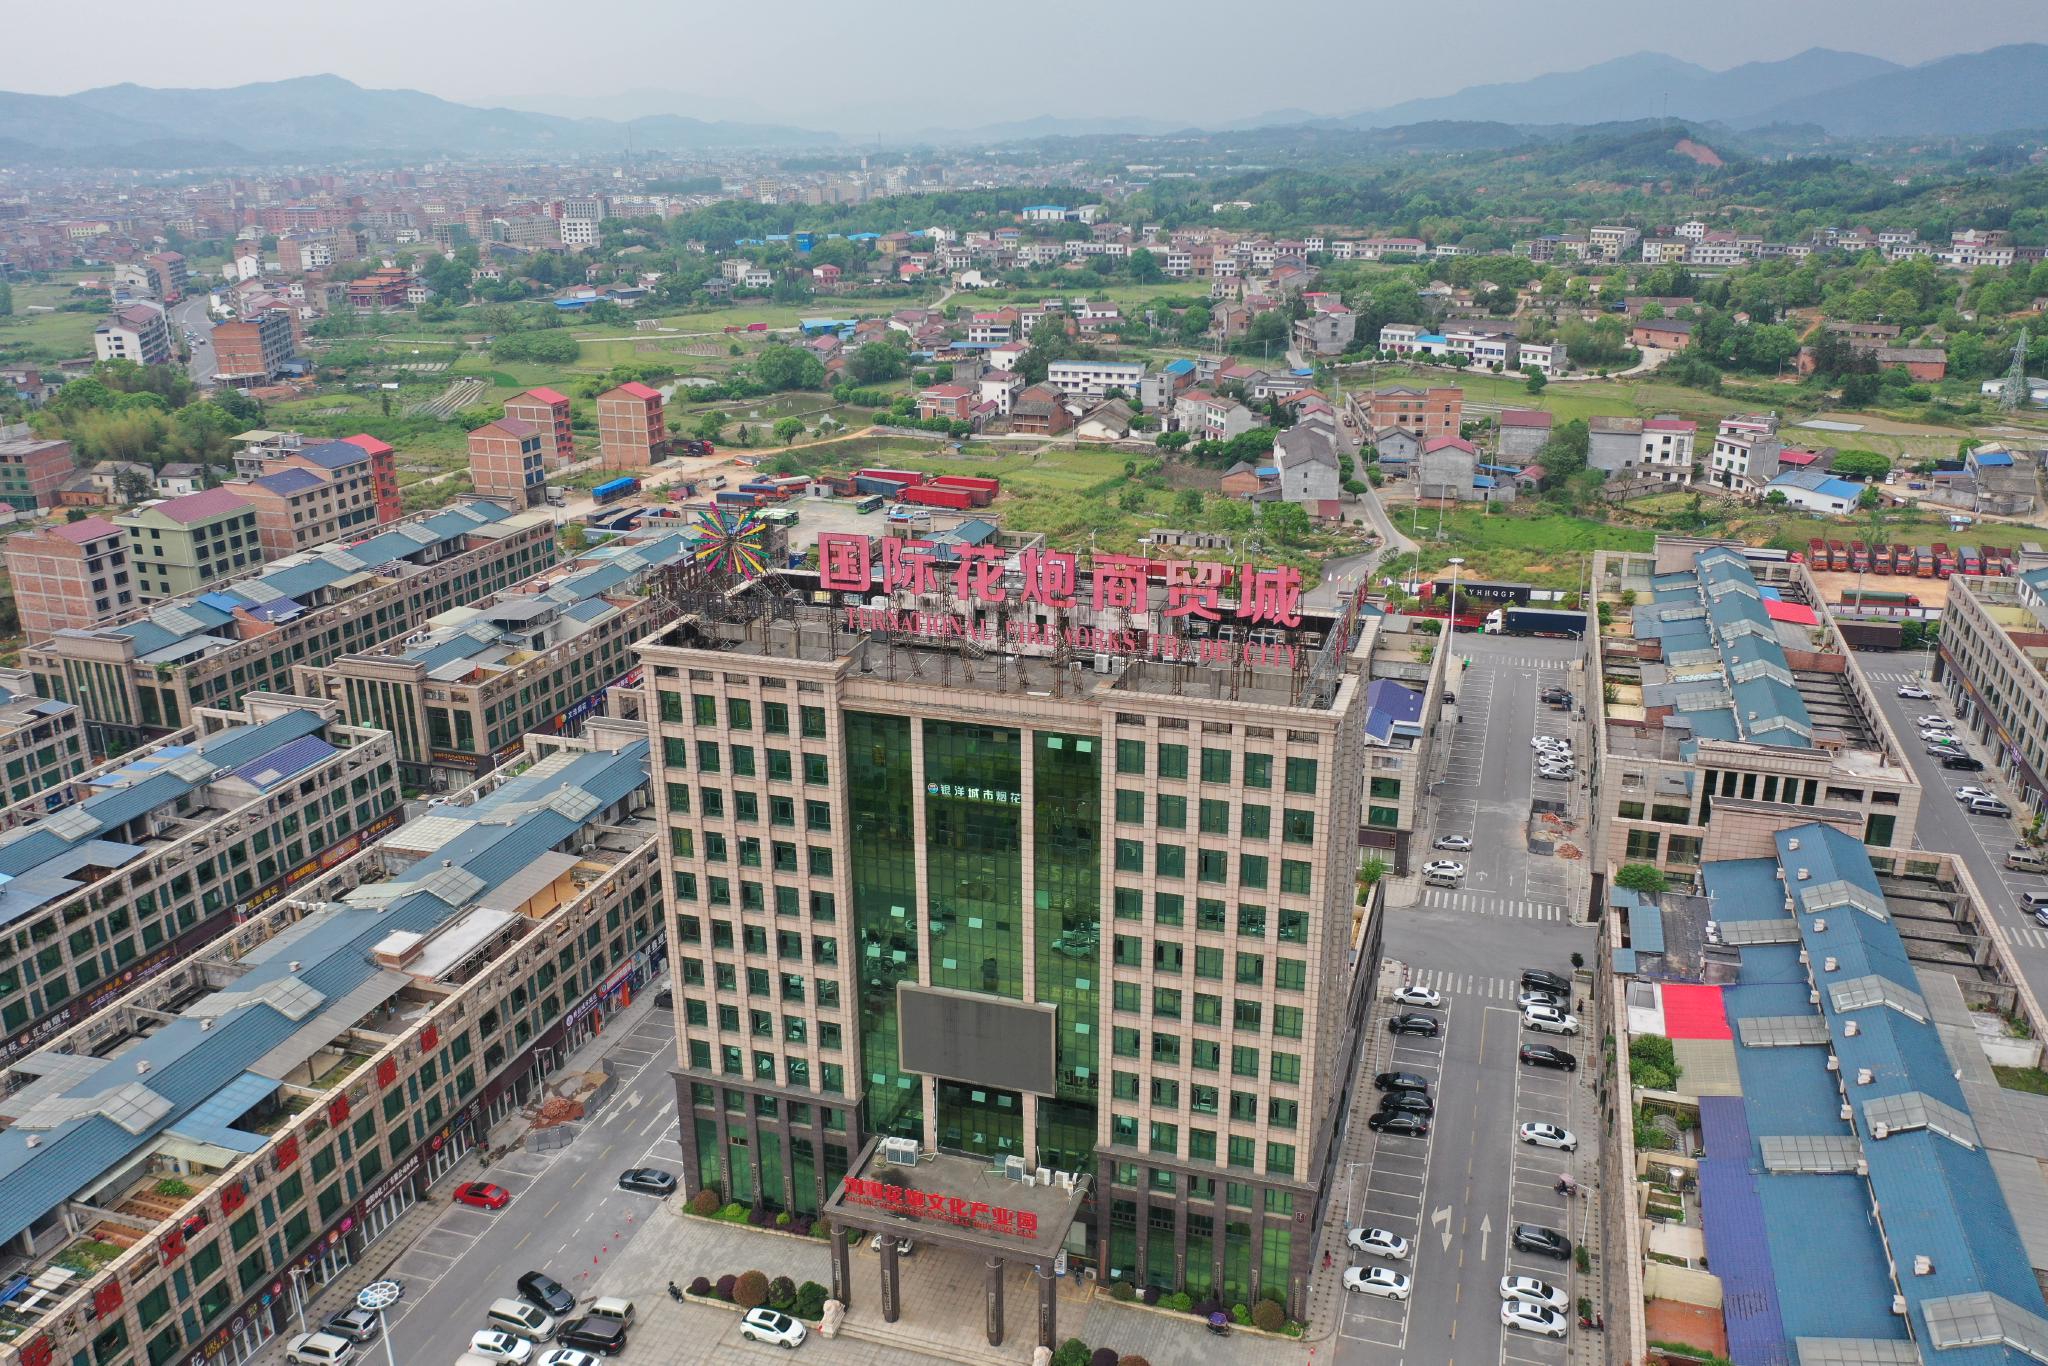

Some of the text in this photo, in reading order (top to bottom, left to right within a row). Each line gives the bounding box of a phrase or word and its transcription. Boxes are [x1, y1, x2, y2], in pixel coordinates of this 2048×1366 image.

[818, 532, 1302, 628] 国际花炮商贸城
[1243, 641, 1300, 669] CITY
[844, 1175, 1038, 1232] 浏阳花炮文化产业园
